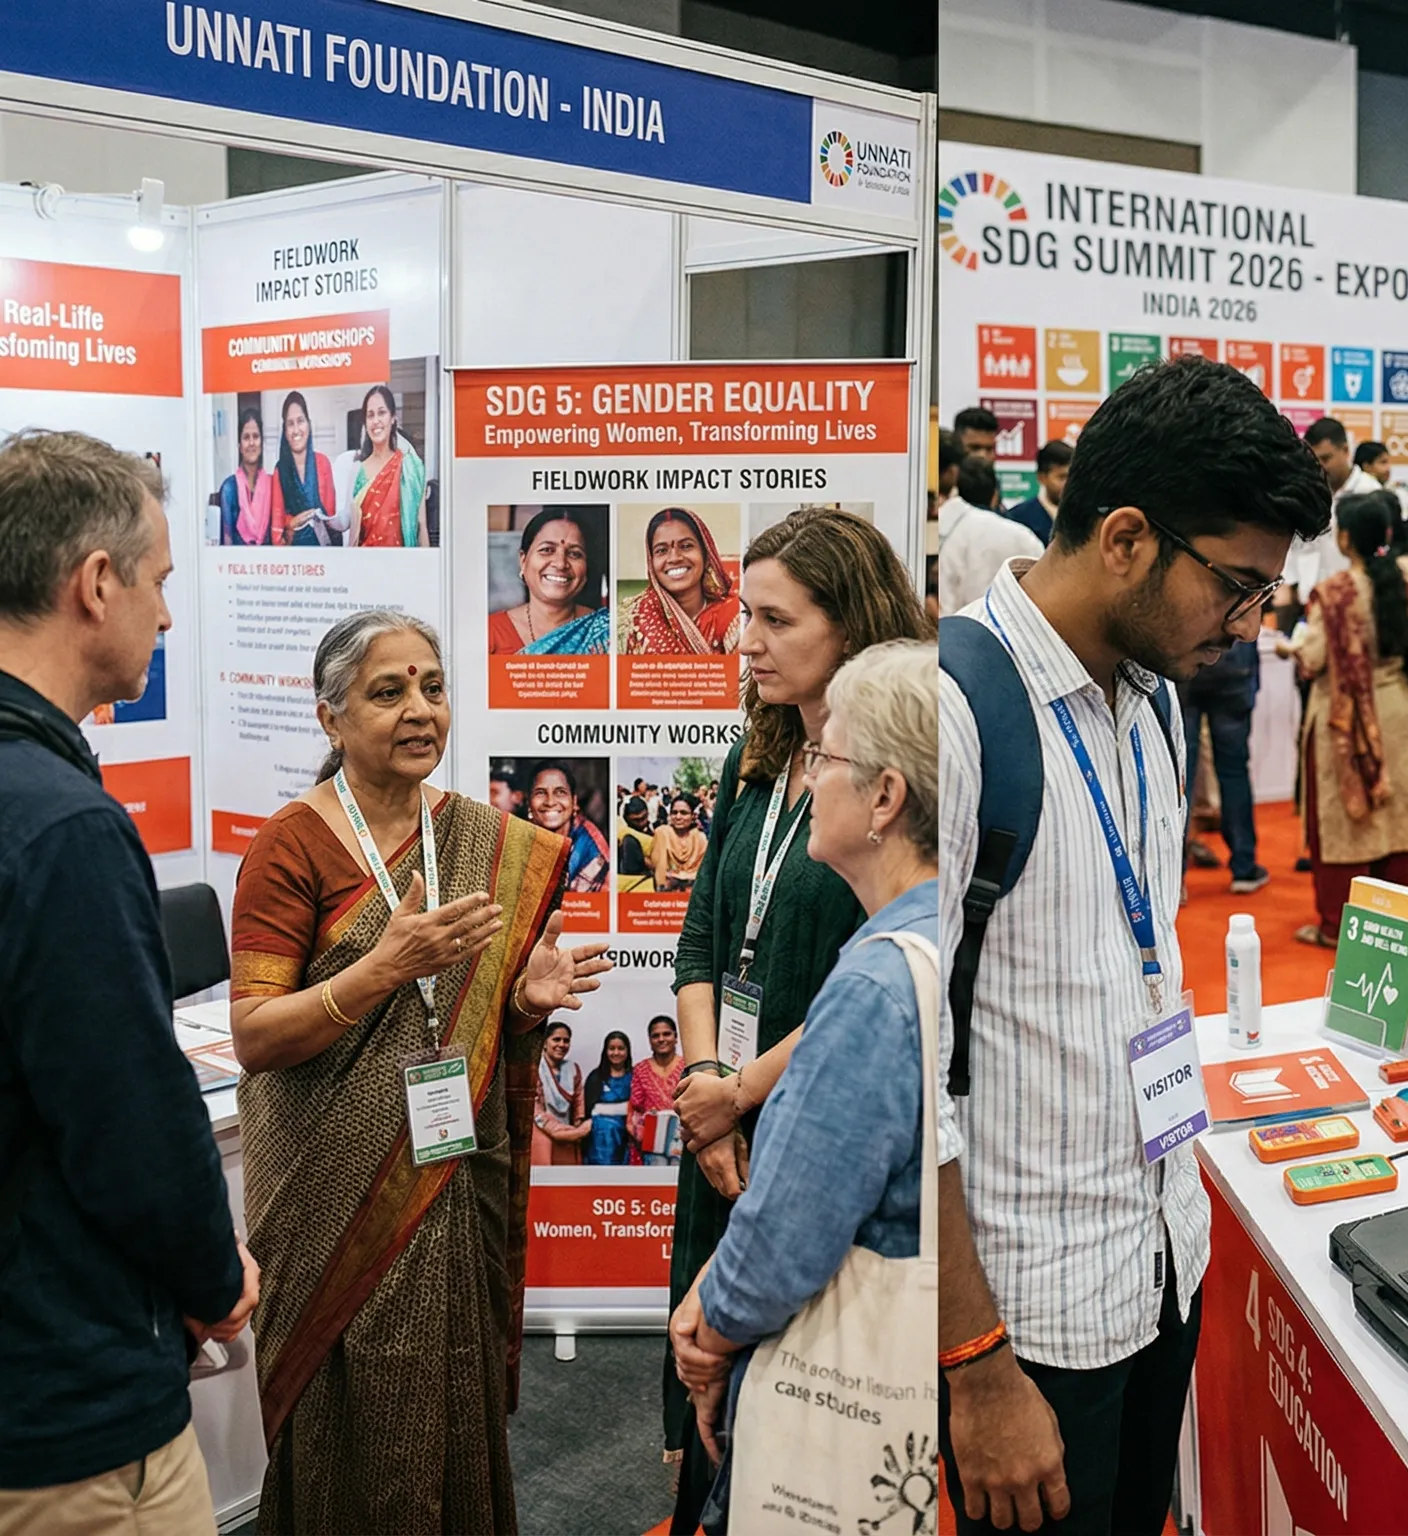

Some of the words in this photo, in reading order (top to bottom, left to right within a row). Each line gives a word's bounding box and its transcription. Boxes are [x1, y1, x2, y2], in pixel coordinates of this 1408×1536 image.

[165, 1, 311, 78] UNNATI
[325, 33, 549, 121] FOUNDATION
[583, 85, 666, 143] INDIA
[857, 140, 911, 169] UNNATI
[1046, 182, 1315, 248] INTERNATIONAL
[274, 238, 360, 271] FIELDWORK
[982, 225, 1058, 270] SDG
[1074, 236, 1216, 283] SUMMIT
[1229, 251, 1303, 292] 2026
[1336, 261, 1408, 301] EXPO
[256, 275, 309, 303] IMPACT
[315, 267, 379, 297] STORIES
[1142, 291, 1201, 318] INDIA
[1209, 298, 1257, 321] 2026
[85, 337, 137, 365] Lives
[228, 334, 298, 358] COMMUNITY
[300, 325, 375, 352] WORKSHOPS
[486, 384, 547, 417] SDG
[555, 385, 582, 416] 5:
[592, 382, 714, 415] GENDER
[724, 380, 874, 414] EQUALITY
[484, 422, 600, 449] Empowering
[605, 422, 683, 446] Women,
[689, 420, 819, 445] Transforming
[825, 419, 877, 441] Lives
[532, 468, 650, 490] FIELDWORK
[656, 468, 732, 490] IMPACT
[740, 467, 827, 489] STORIES
[537, 723, 661, 744] COMMUNITY
[667, 723, 741, 744] WORKS
[1347, 915, 1359, 941] 3
[1142, 1063, 1193, 1101] VISITOR
[592, 1198, 626, 1216] SDG
[631, 1199, 646, 1216] 5:
[533, 1221, 598, 1241] Women,
[1246, 1269, 1261, 1352] 4
[1268, 1296, 1294, 1372] SDG
[1298, 1344, 1312, 1395] 4:
[775, 1380, 811, 1403] case
[815, 1391, 882, 1425] studies
[1268, 1350, 1348, 1522] EDUCATION
